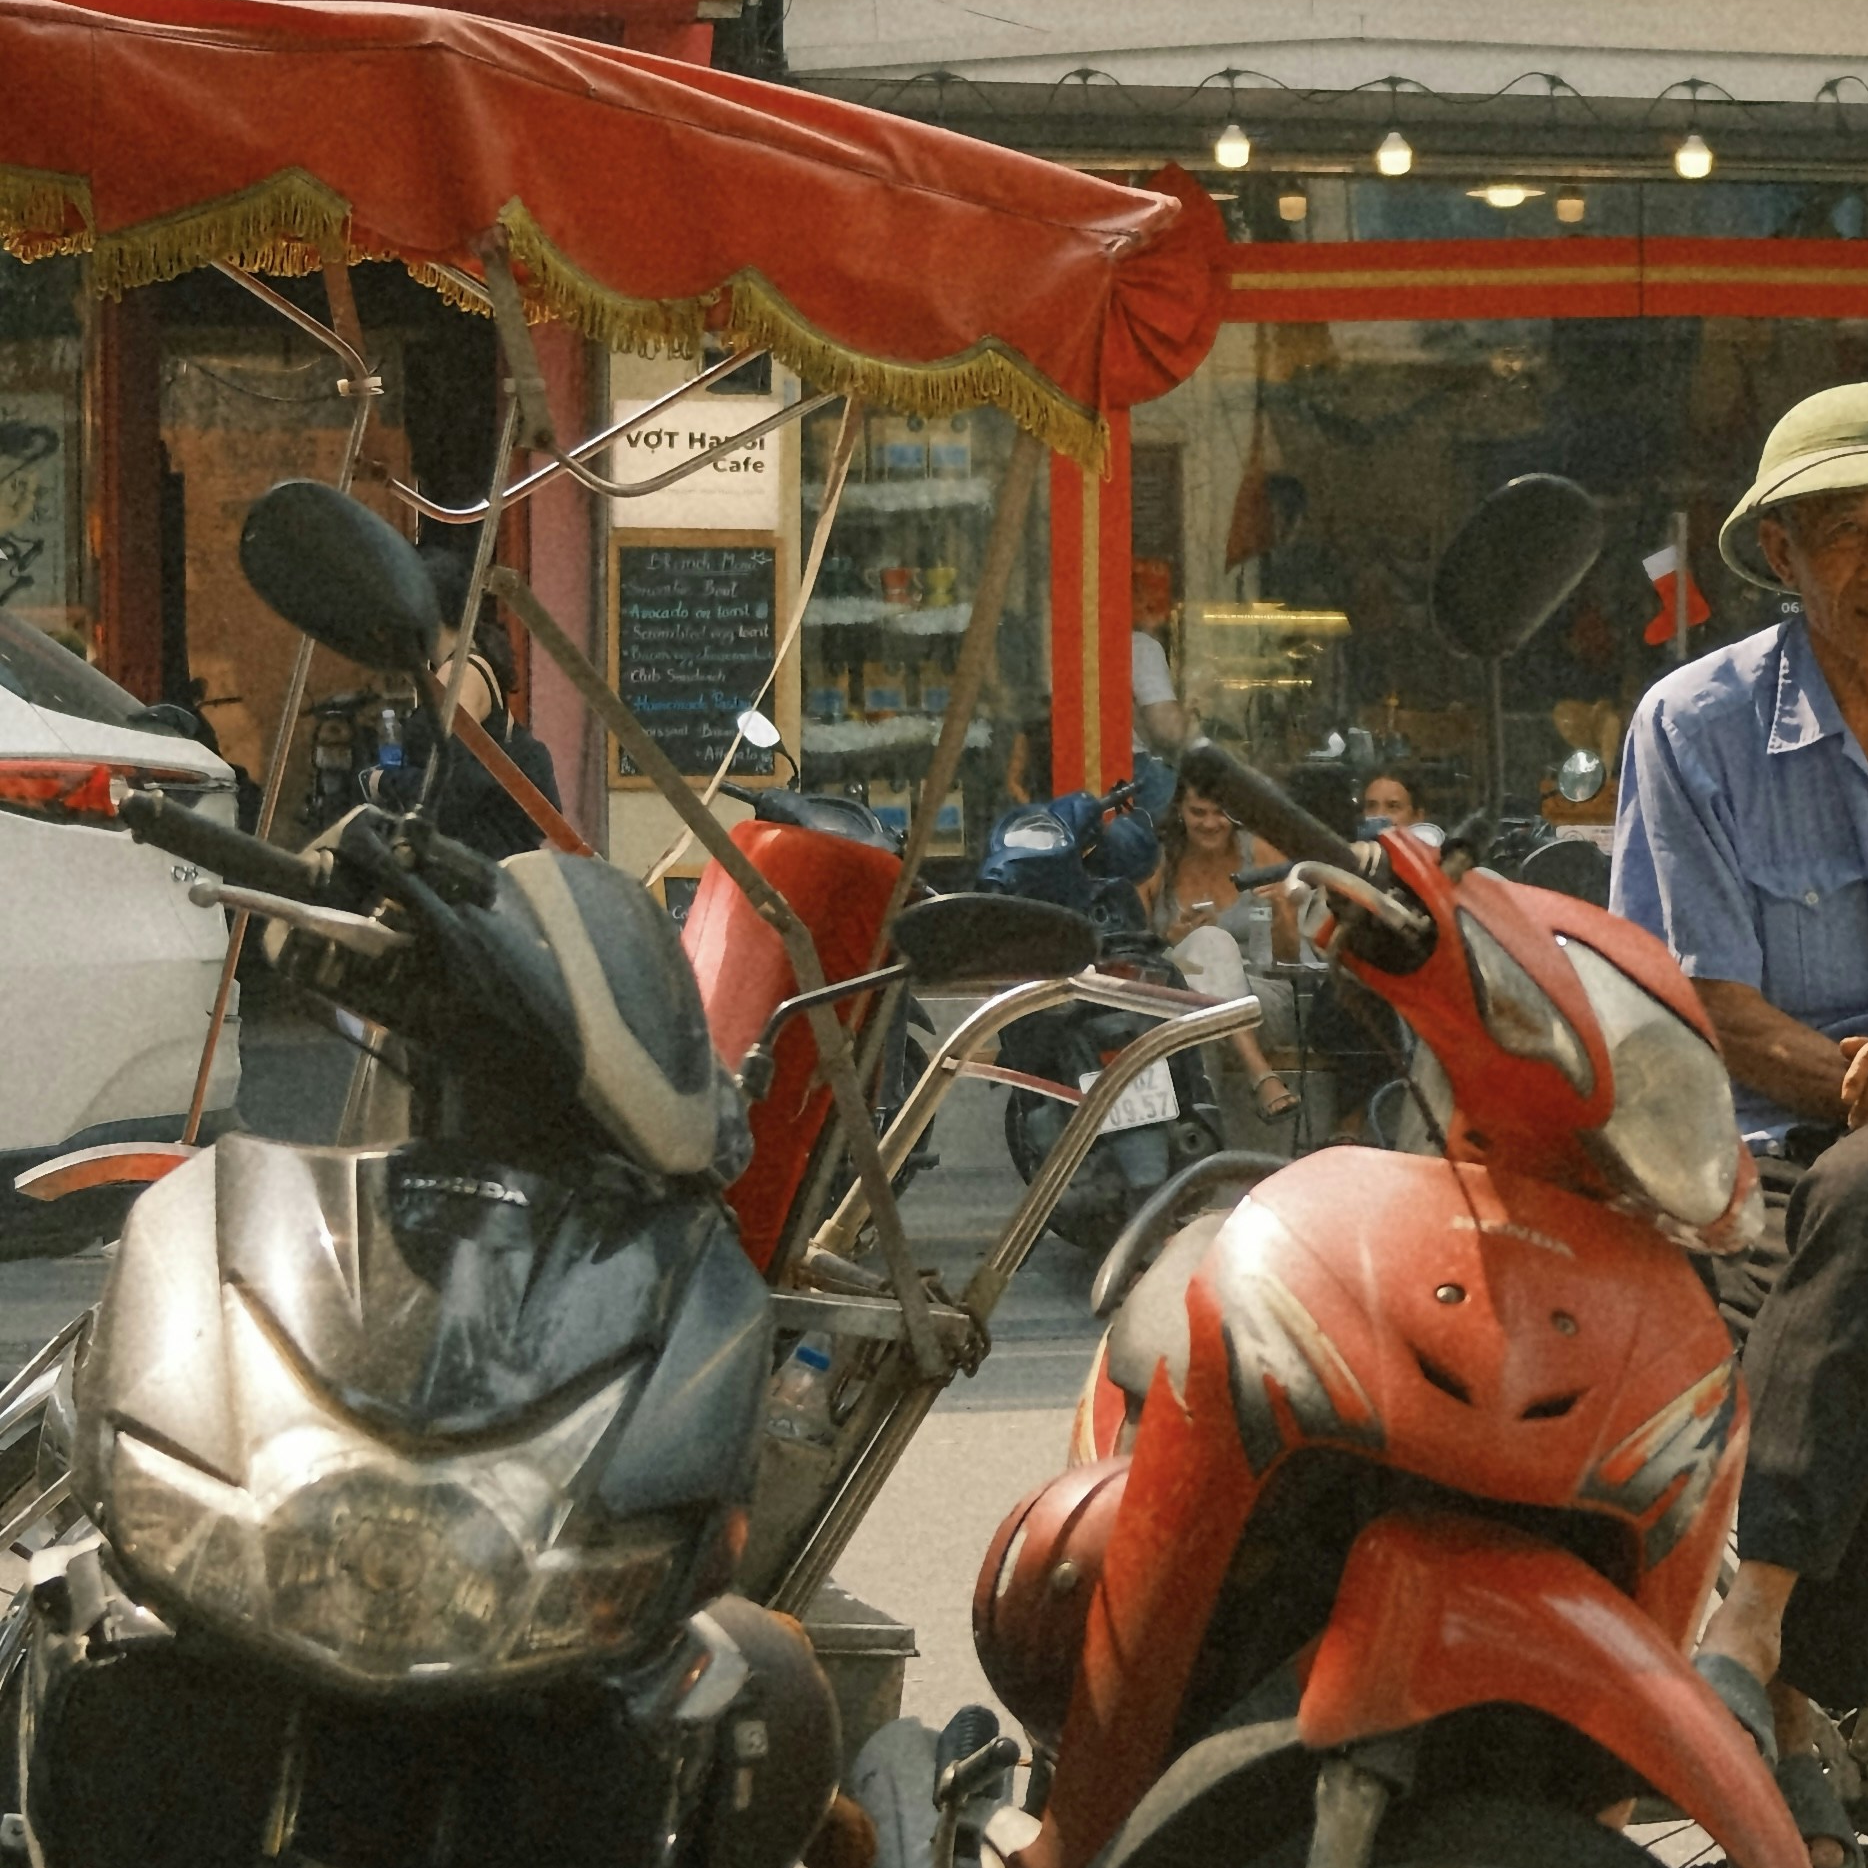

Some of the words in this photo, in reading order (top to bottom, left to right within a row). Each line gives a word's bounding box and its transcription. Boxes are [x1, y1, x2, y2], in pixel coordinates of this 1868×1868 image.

[625, 428, 680, 455] VỢT
[688, 431, 765, 451] Haoi
[712, 456, 765, 473] Cafe
[630, 599, 690, 620] Avocado
[630, 667, 662, 684] Club
